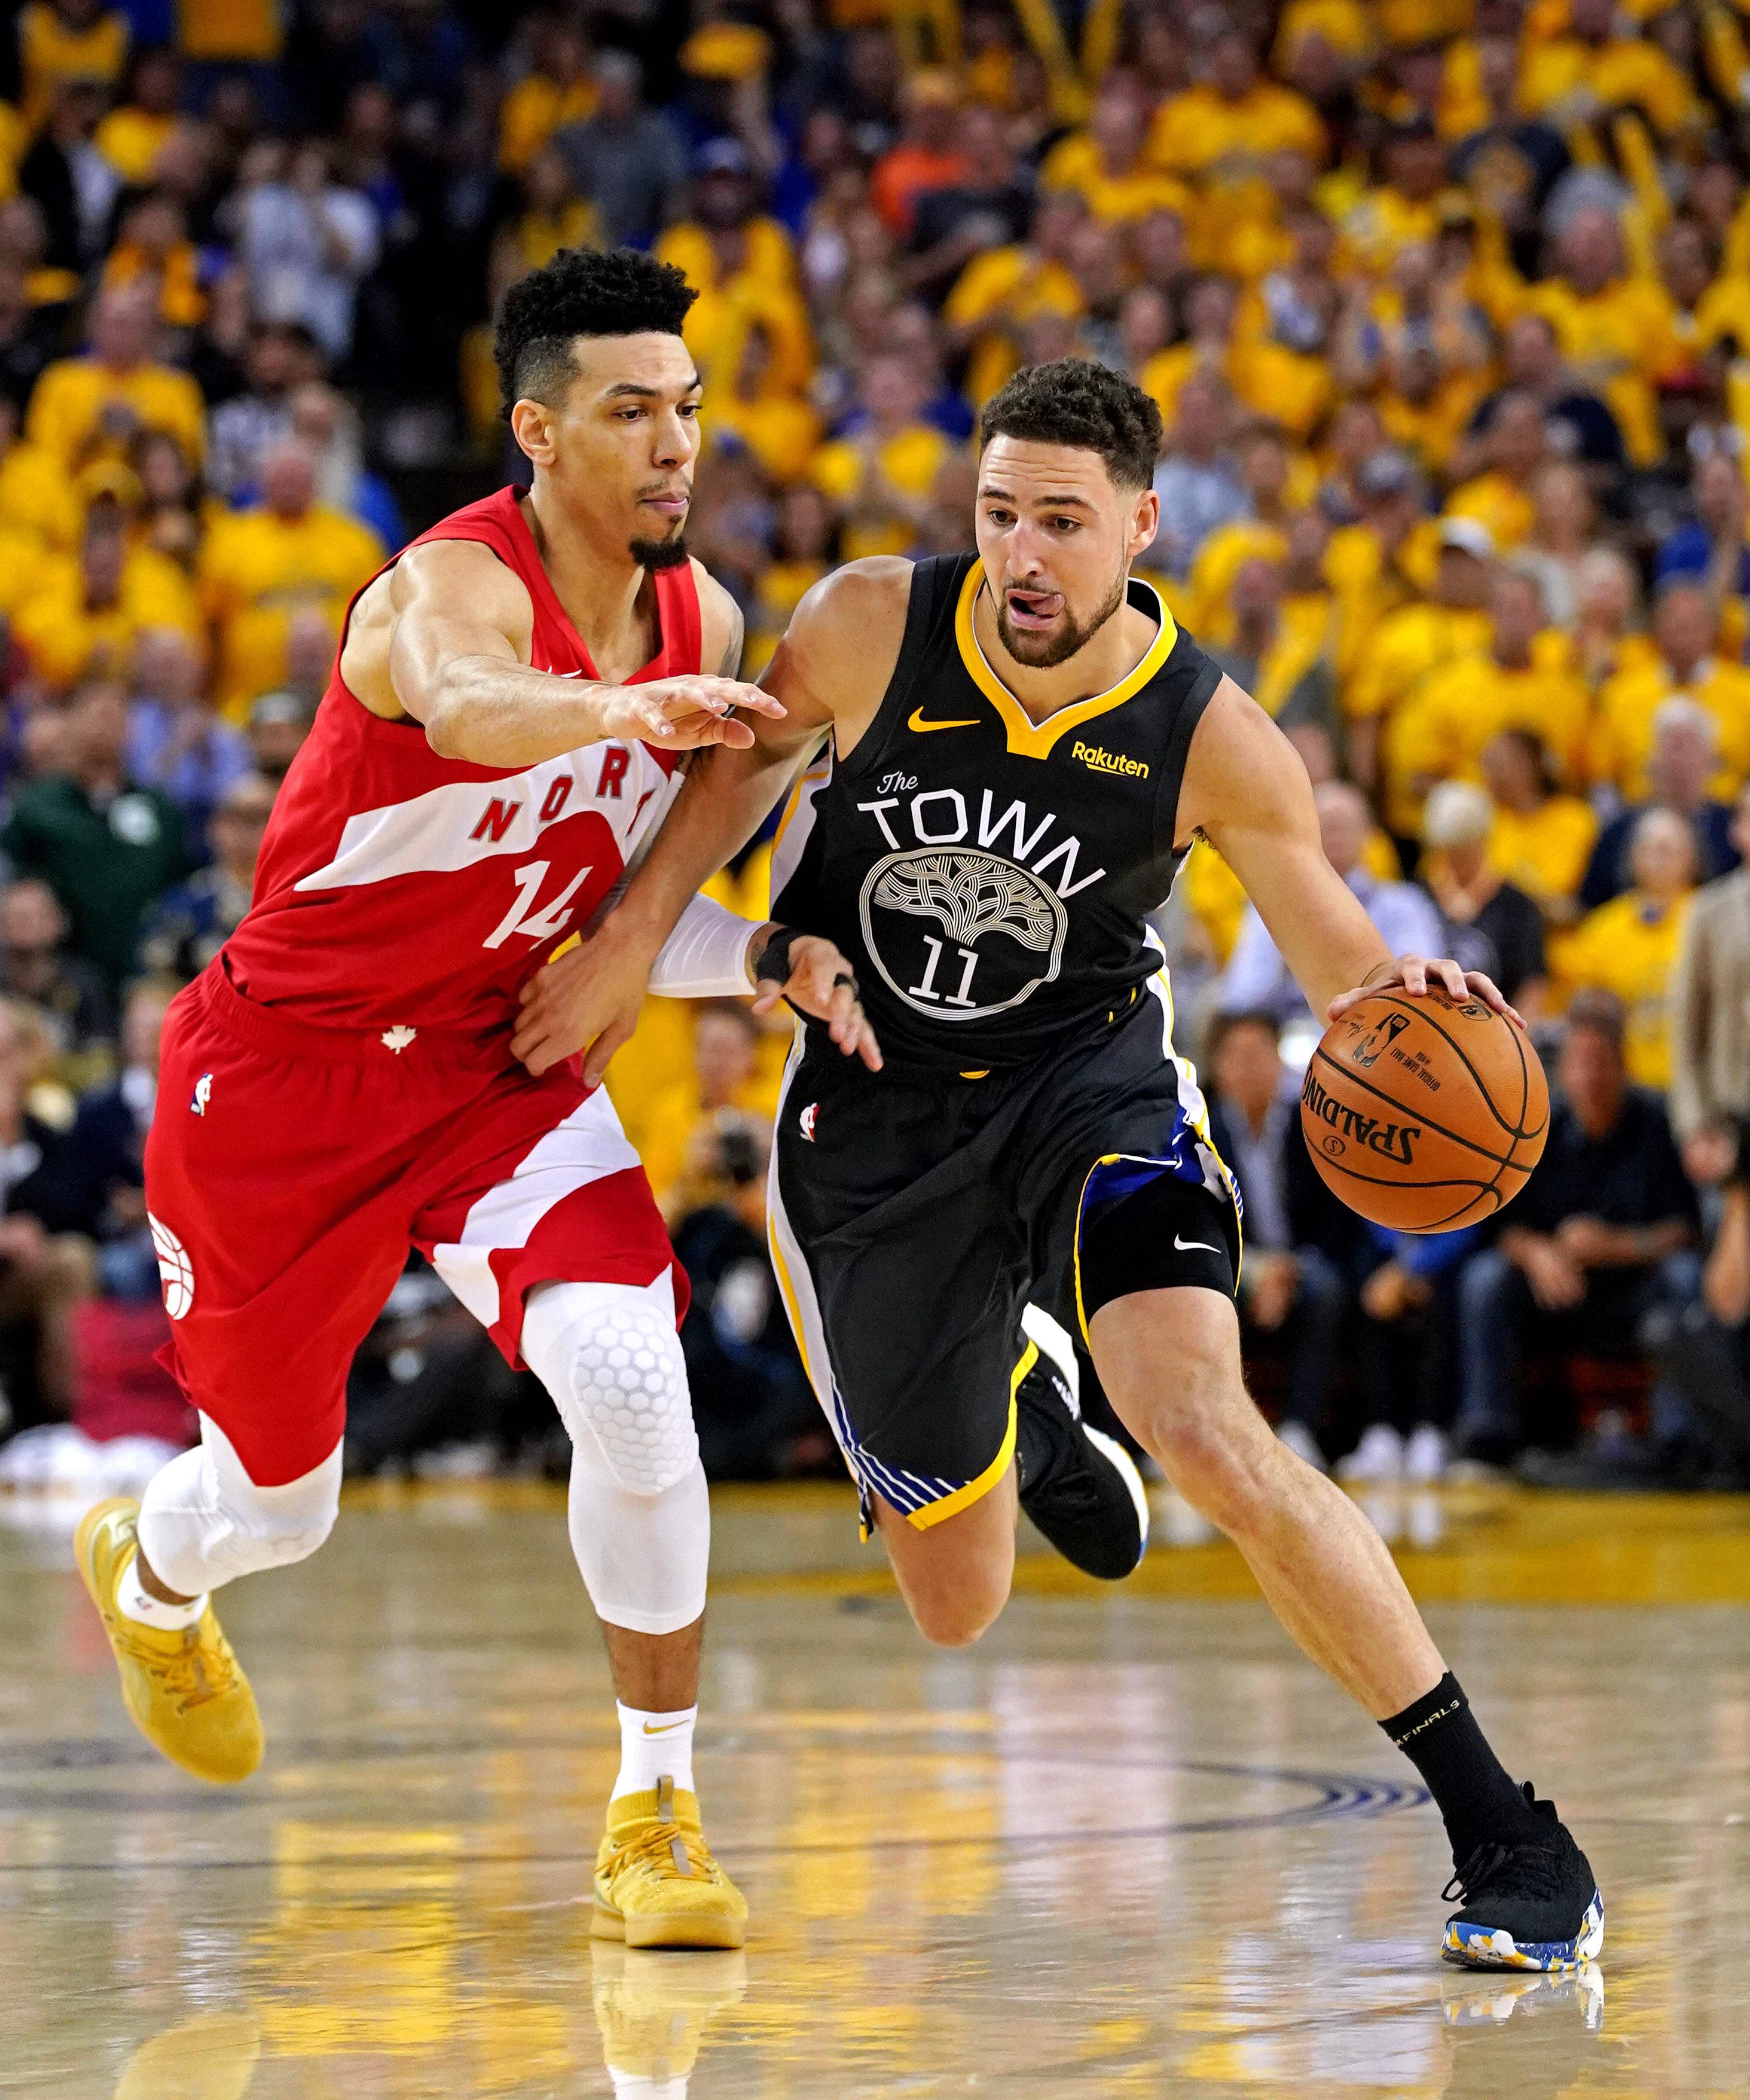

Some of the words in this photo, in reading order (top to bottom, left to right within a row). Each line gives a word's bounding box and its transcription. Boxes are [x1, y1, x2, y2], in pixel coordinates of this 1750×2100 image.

[1072, 741, 1149, 779] Rakuten
[876, 771, 918, 794] The
[857, 788, 1106, 898] TOWN
[482, 860, 594, 952] 14
[908, 935, 979, 1008] 11
[1402, 1056, 1421, 1073] GAME
[1417, 1068, 1441, 1092] OFFICIAL
[1403, 1699, 1460, 1742] FINALS
